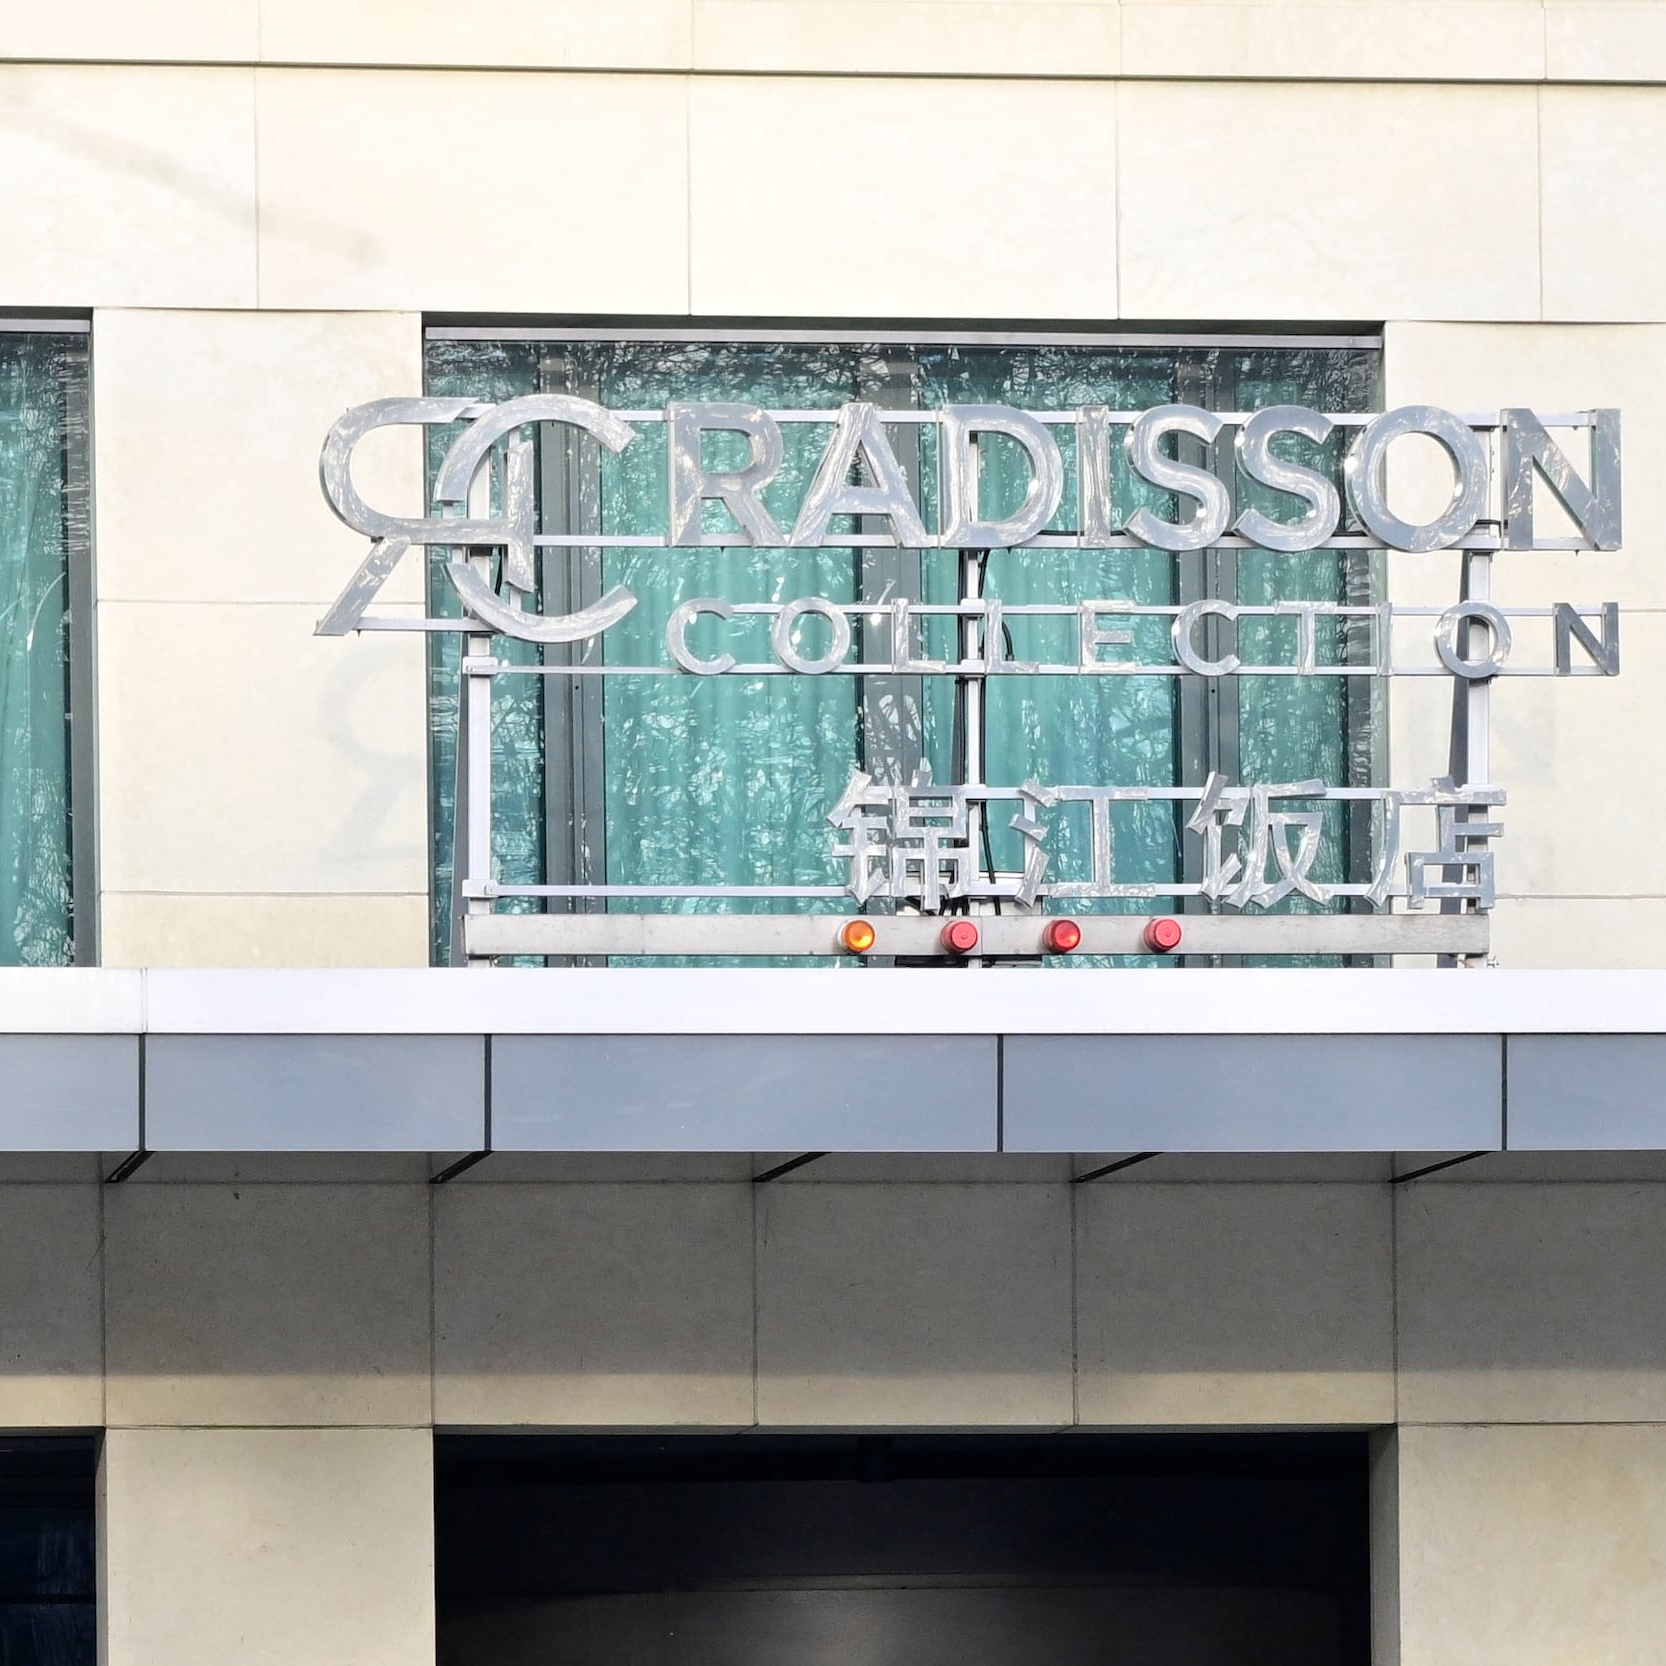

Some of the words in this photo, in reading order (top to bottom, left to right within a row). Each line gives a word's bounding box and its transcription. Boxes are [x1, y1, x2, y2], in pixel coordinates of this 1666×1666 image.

[667, 401, 1623, 553] RADISSON
[664, 597, 1621, 678] COLLECTION
[825, 770, 1507, 912] 锦江饭店
